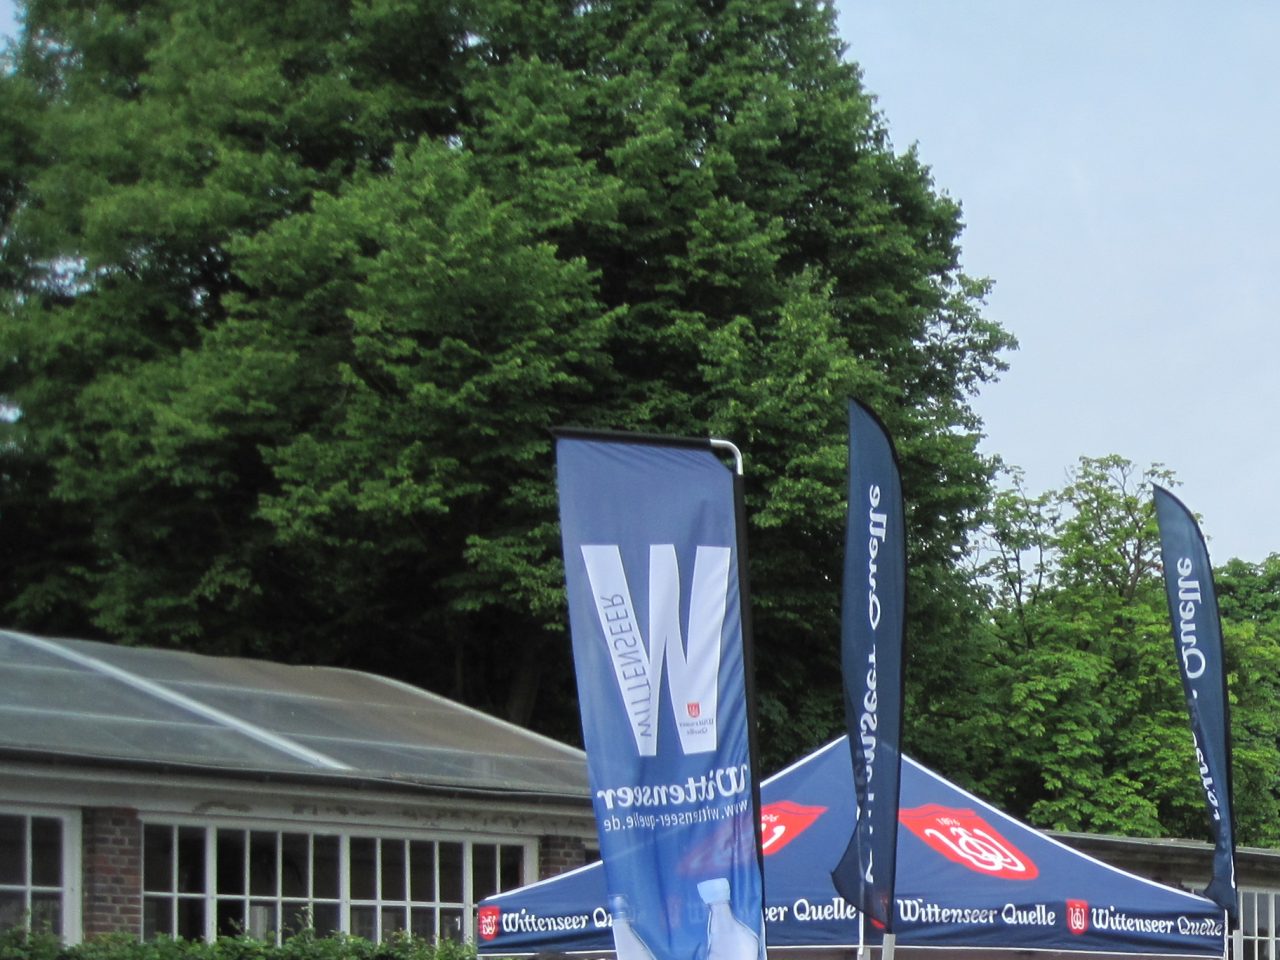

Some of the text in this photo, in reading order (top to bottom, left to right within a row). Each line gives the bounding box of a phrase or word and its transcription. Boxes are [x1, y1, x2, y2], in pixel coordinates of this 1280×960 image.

[502, 908, 588, 932] Wittenseer
[793, 897, 857, 921] Quelle
[897, 898, 1056, 925] Wittenseer Quelle
[1091, 905, 1222, 936] Wittenseer Quelle
